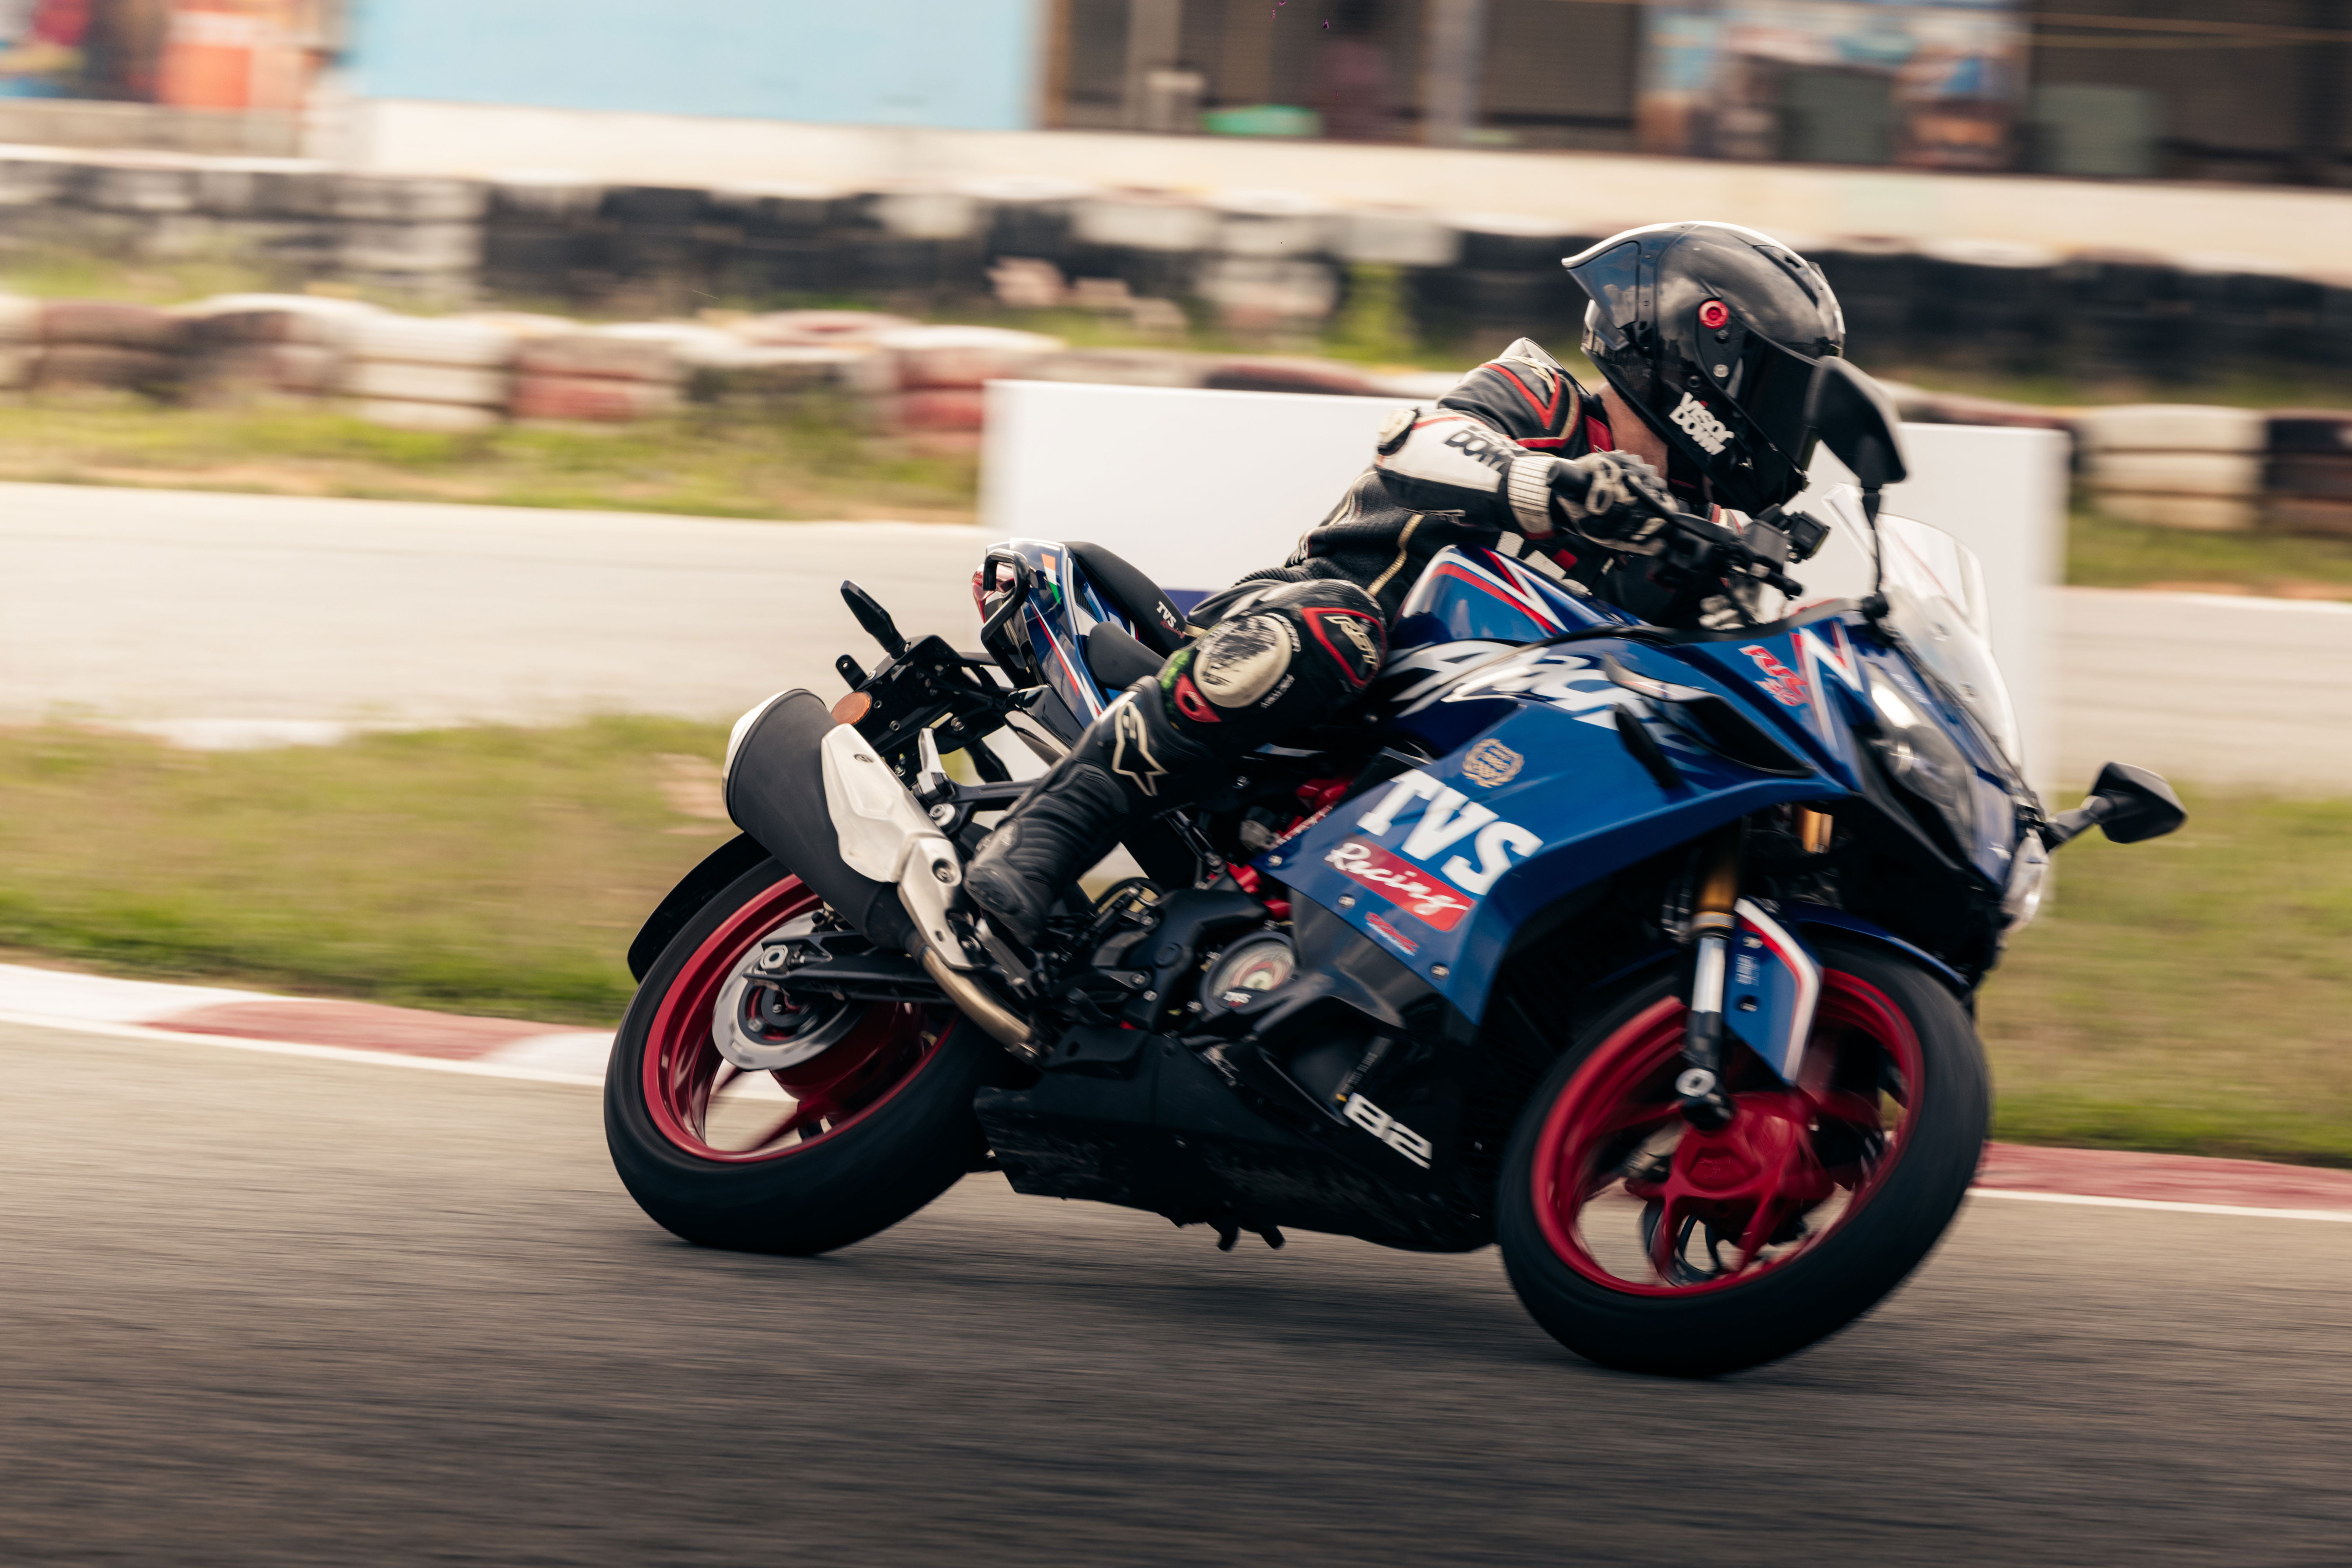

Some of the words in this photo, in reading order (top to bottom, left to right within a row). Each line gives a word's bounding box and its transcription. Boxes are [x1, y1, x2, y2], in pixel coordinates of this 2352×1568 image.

[1669, 405, 1726, 455] DOWN
[1156, 601, 1177, 628] TVS
[1356, 769, 1544, 895] TVS
[1324, 842, 1469, 916] Racing
[1343, 1093, 1433, 1169] 82
